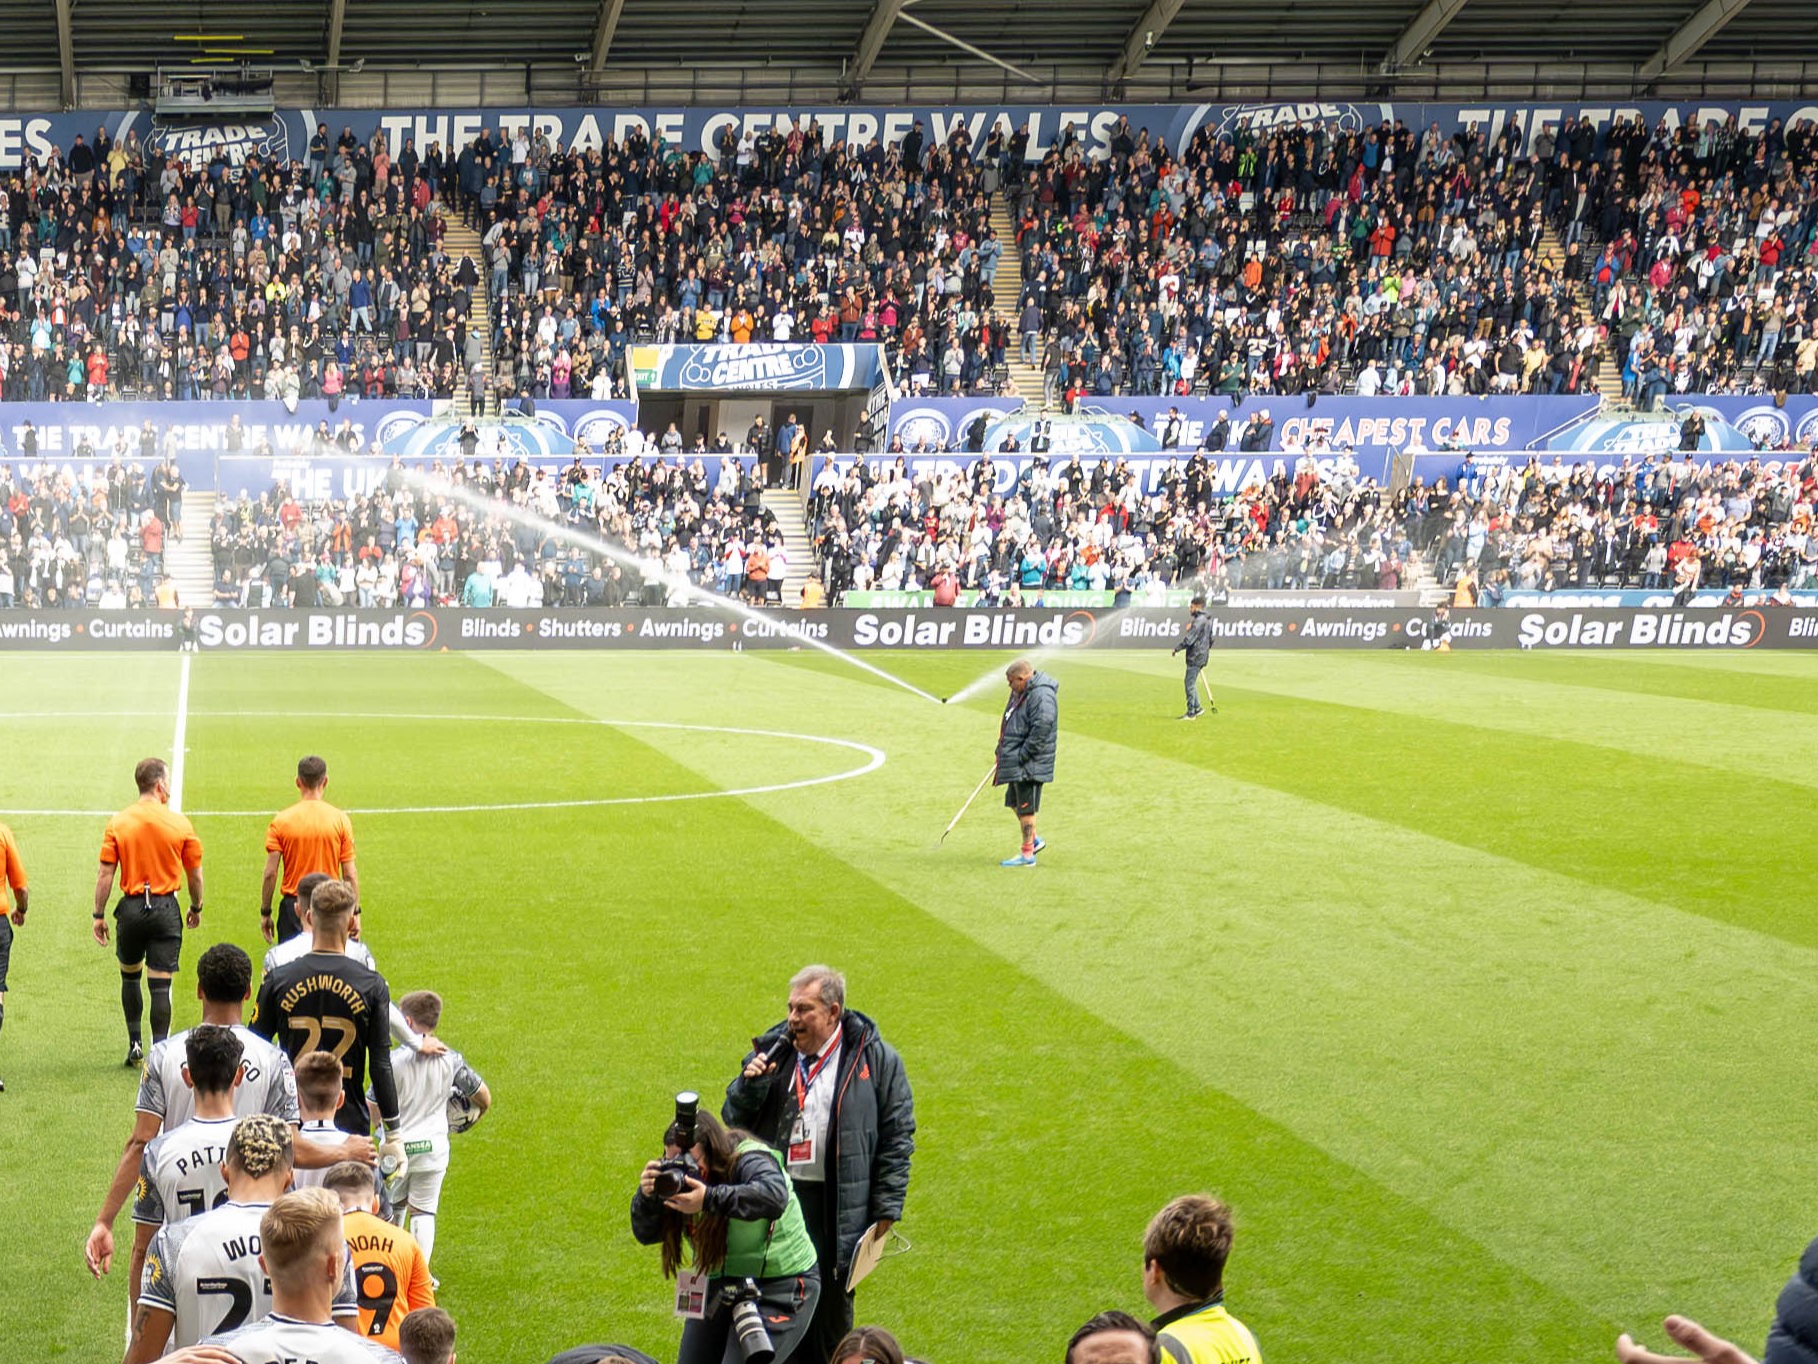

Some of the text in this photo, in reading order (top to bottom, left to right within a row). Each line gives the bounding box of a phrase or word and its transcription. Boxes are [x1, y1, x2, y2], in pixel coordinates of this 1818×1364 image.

[165, 123, 268, 152] TRADE
[711, 358, 793, 385] CENTRE
[1432, 417, 1511, 446] CARS
[89, 619, 174, 639] Curtains
[199, 614, 425, 647] Solar Blinds
[461, 617, 828, 642] Blinds Shutters Awnings Curtains
[853, 614, 1083, 646] Solar Blinds
[1120, 617, 1387, 640] Blinds Awnings
[1518, 614, 1751, 646] Solar Blinds
[280, 974, 366, 1015] RUSHWORTH
[355, 1262, 398, 1336] 9
